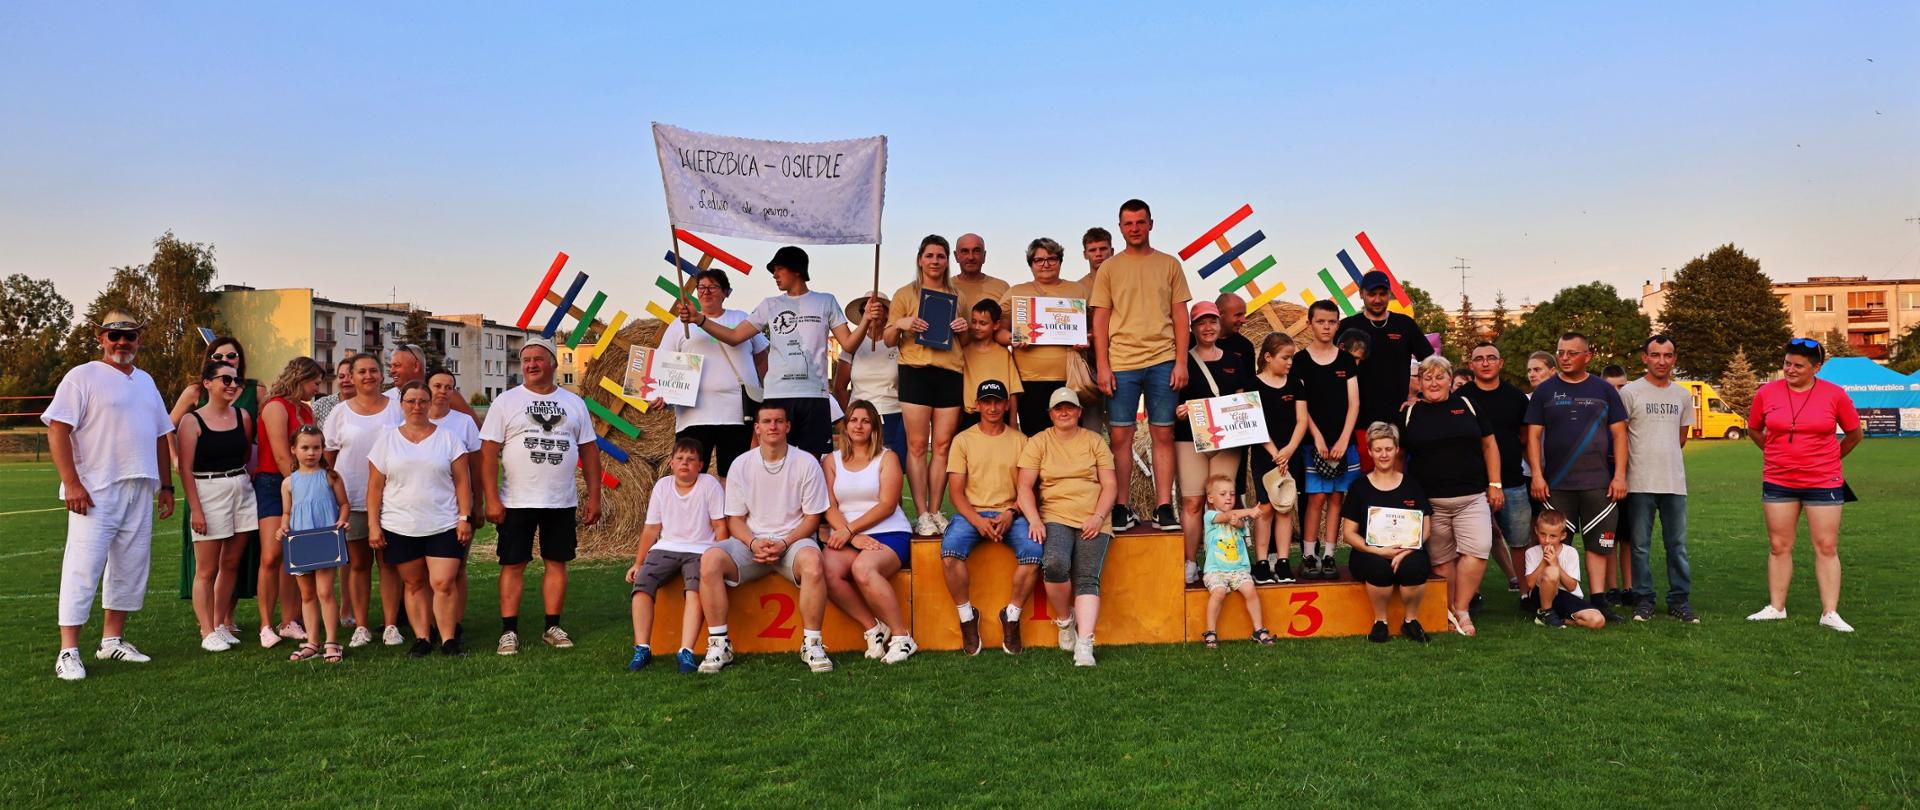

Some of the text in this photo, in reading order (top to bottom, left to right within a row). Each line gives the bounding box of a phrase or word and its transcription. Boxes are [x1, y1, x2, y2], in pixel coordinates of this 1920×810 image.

[678, 147, 760, 177] WIERZBICA
[781, 153, 843, 178] OSIEDLE
[1045, 323, 1078, 331] VOUCHER
[658, 379, 690, 390] VOUCHER
[981, 383, 1001, 391] NASA
[1868, 384, 1904, 392] Wierzbica
[525, 405, 567, 416] JEDNOSTKA
[1645, 402, 1679, 416] BIG STAR
[1224, 420, 1258, 432] VOUCHER
[757, 593, 797, 639] 2
[1287, 591, 1324, 637] 3
